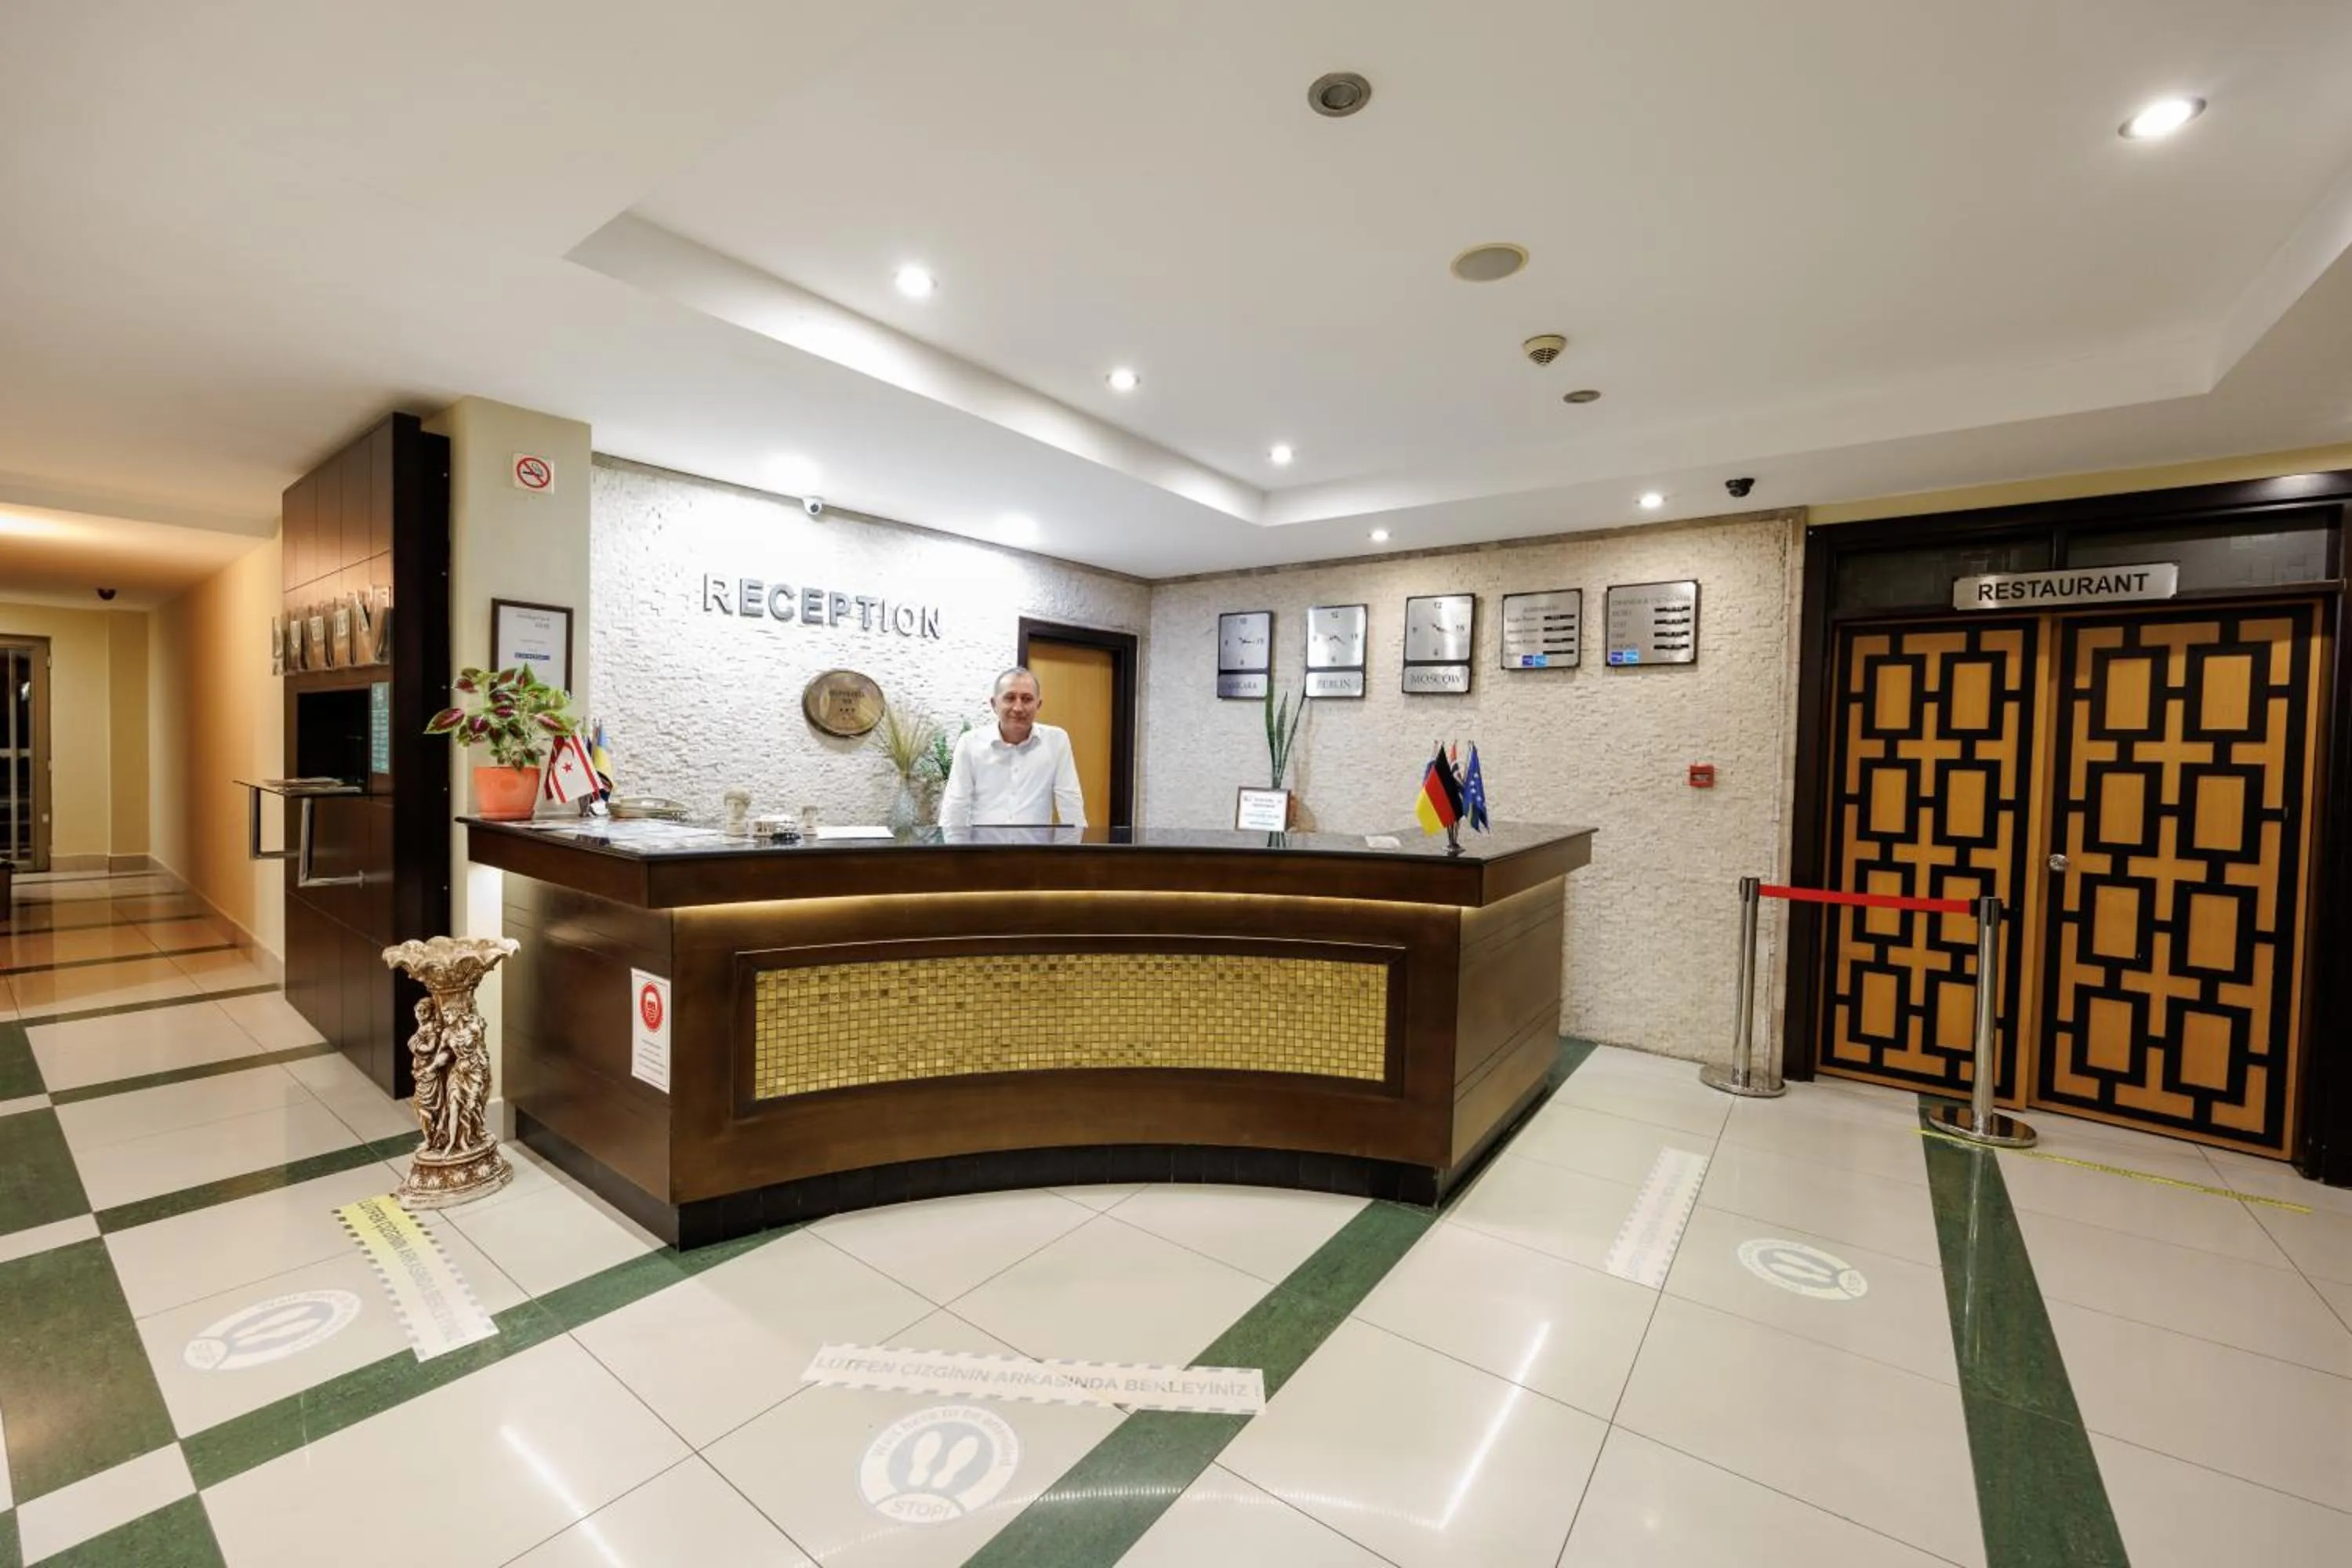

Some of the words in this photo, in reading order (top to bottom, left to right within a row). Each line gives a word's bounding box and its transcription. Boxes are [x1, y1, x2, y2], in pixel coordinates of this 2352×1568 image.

[1977, 572, 2150, 601] RESTAURANT
[703, 573, 940, 640] RECEPTION
[1410, 673, 1461, 685] MOSCOW
[993, 1369, 1119, 1391] ARKASINDA
